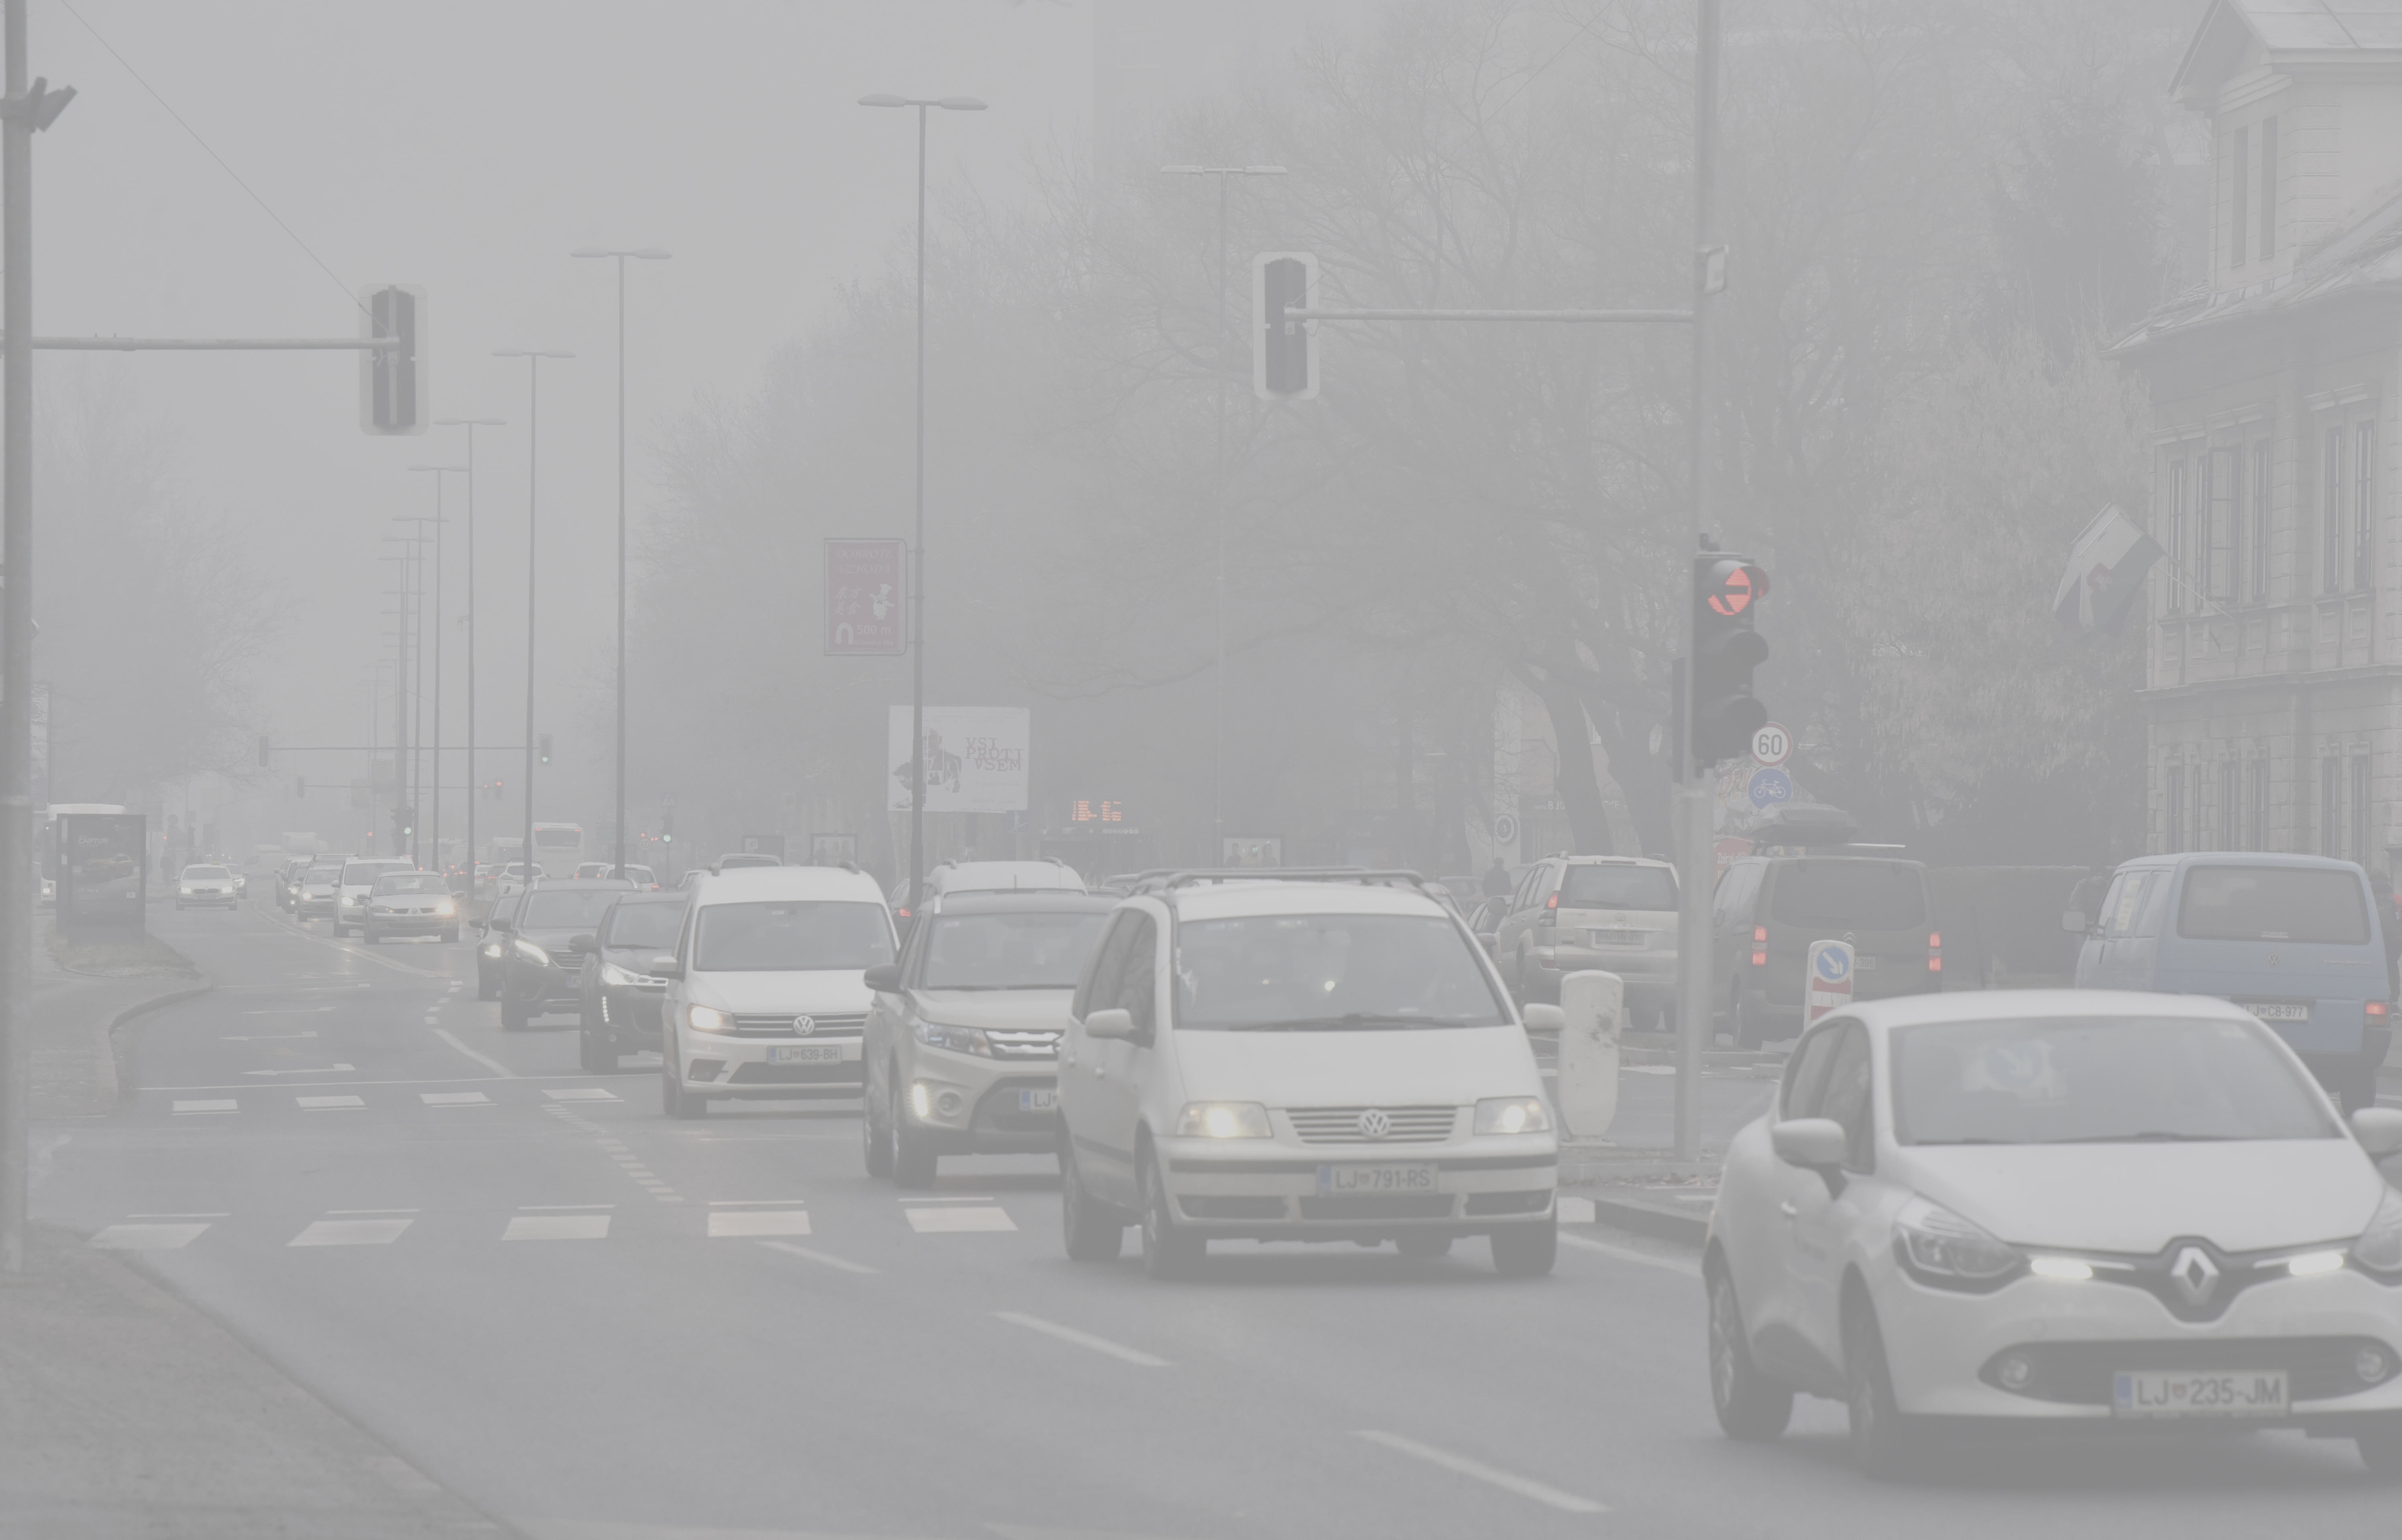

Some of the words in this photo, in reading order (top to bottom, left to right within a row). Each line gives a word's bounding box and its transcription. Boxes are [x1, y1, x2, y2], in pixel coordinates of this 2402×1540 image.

[857, 624, 877, 634] 500
[965, 737, 998, 750] VSI
[1758, 734, 1782, 755] 60
[965, 746, 1025, 761] PROTI
[974, 758, 1022, 771] VSEM
[2268, 1005, 2303, 1017] C8-977
[779, 1049, 793, 1061] LJ
[1034, 1092, 1051, 1107] LJ
[1336, 1170, 1358, 1188] LJ
[1372, 1169, 1431, 1188] 791-RS
[2137, 1377, 2168, 1405] LJ
[2189, 1377, 2281, 1406] 235-JM
